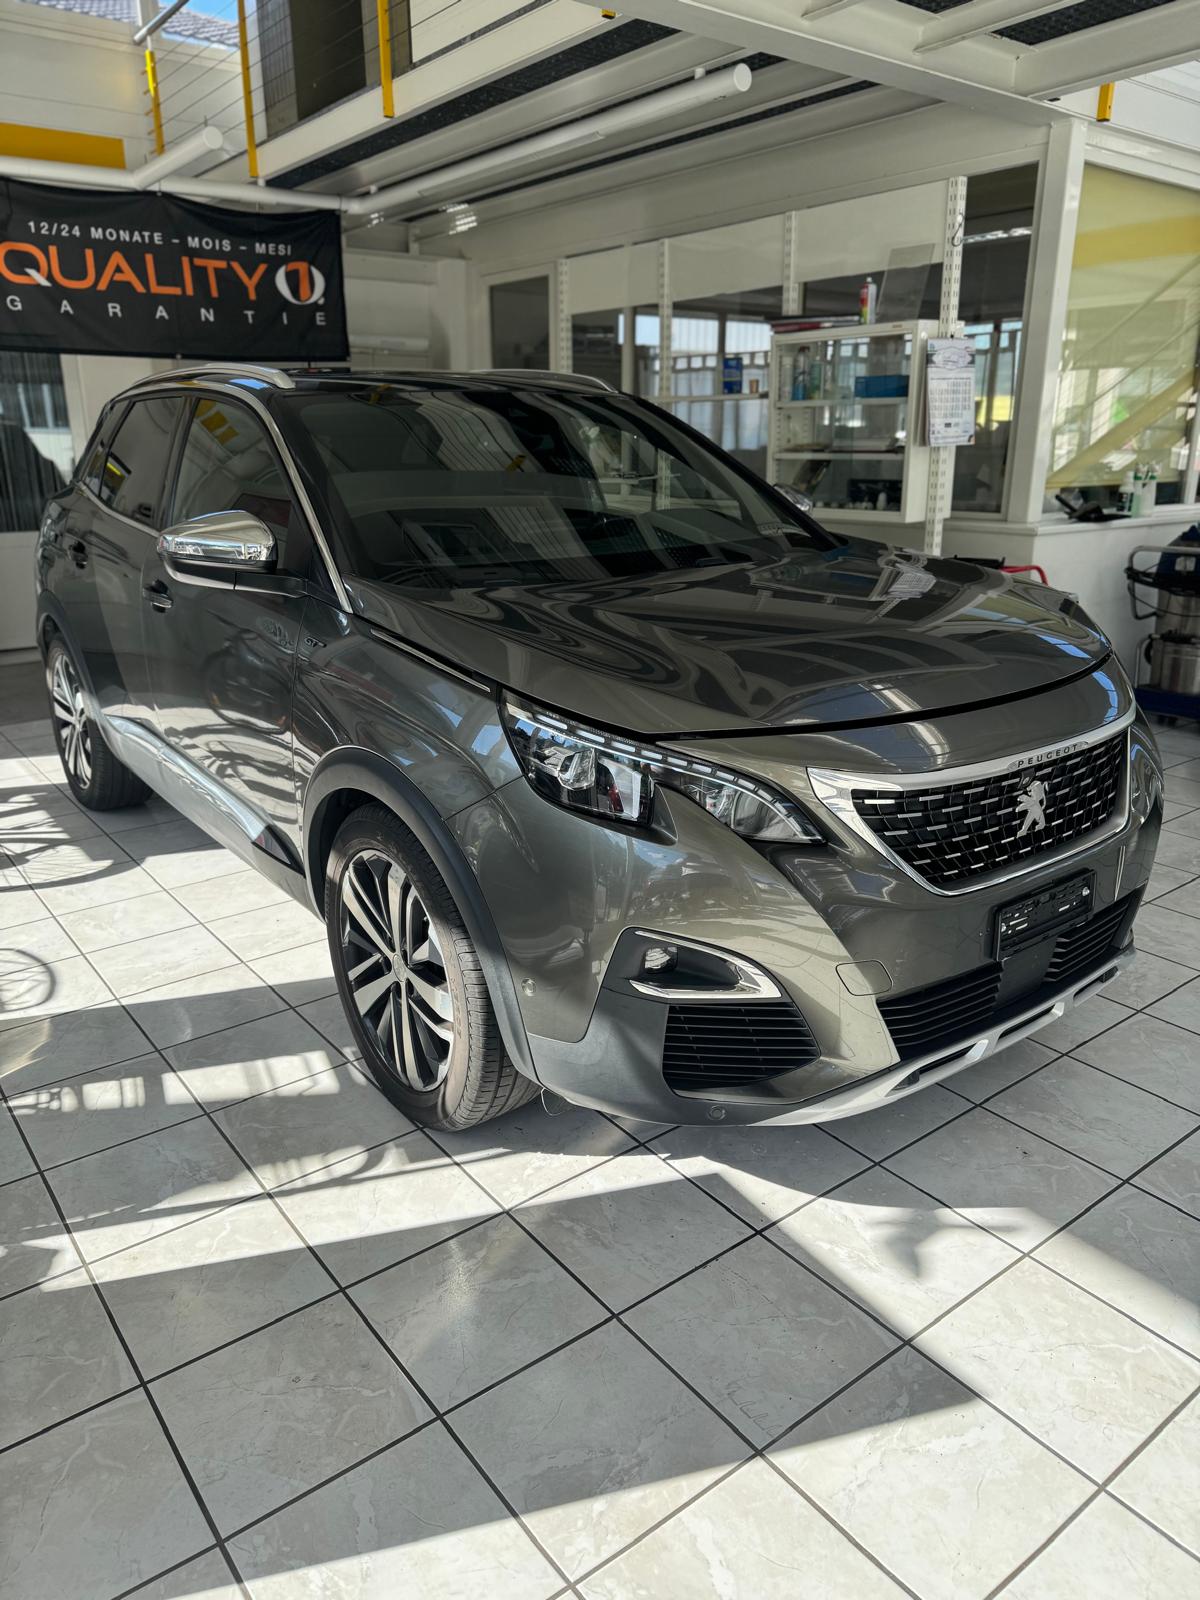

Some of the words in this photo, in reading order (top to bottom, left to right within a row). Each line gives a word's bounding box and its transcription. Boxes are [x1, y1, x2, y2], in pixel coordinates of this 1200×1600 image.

[28, 221, 81, 239] 12/24
[90, 226, 163, 245] MONATE
[188, 236, 232, 253] MOIS
[255, 243, 293, 257] MESI
[0, 241, 268, 301] QUALITY
[6, 296, 327, 326] GARANTIE
[304, 636, 326, 648] GT
[1017, 743, 1078, 768] PEUGEOT
